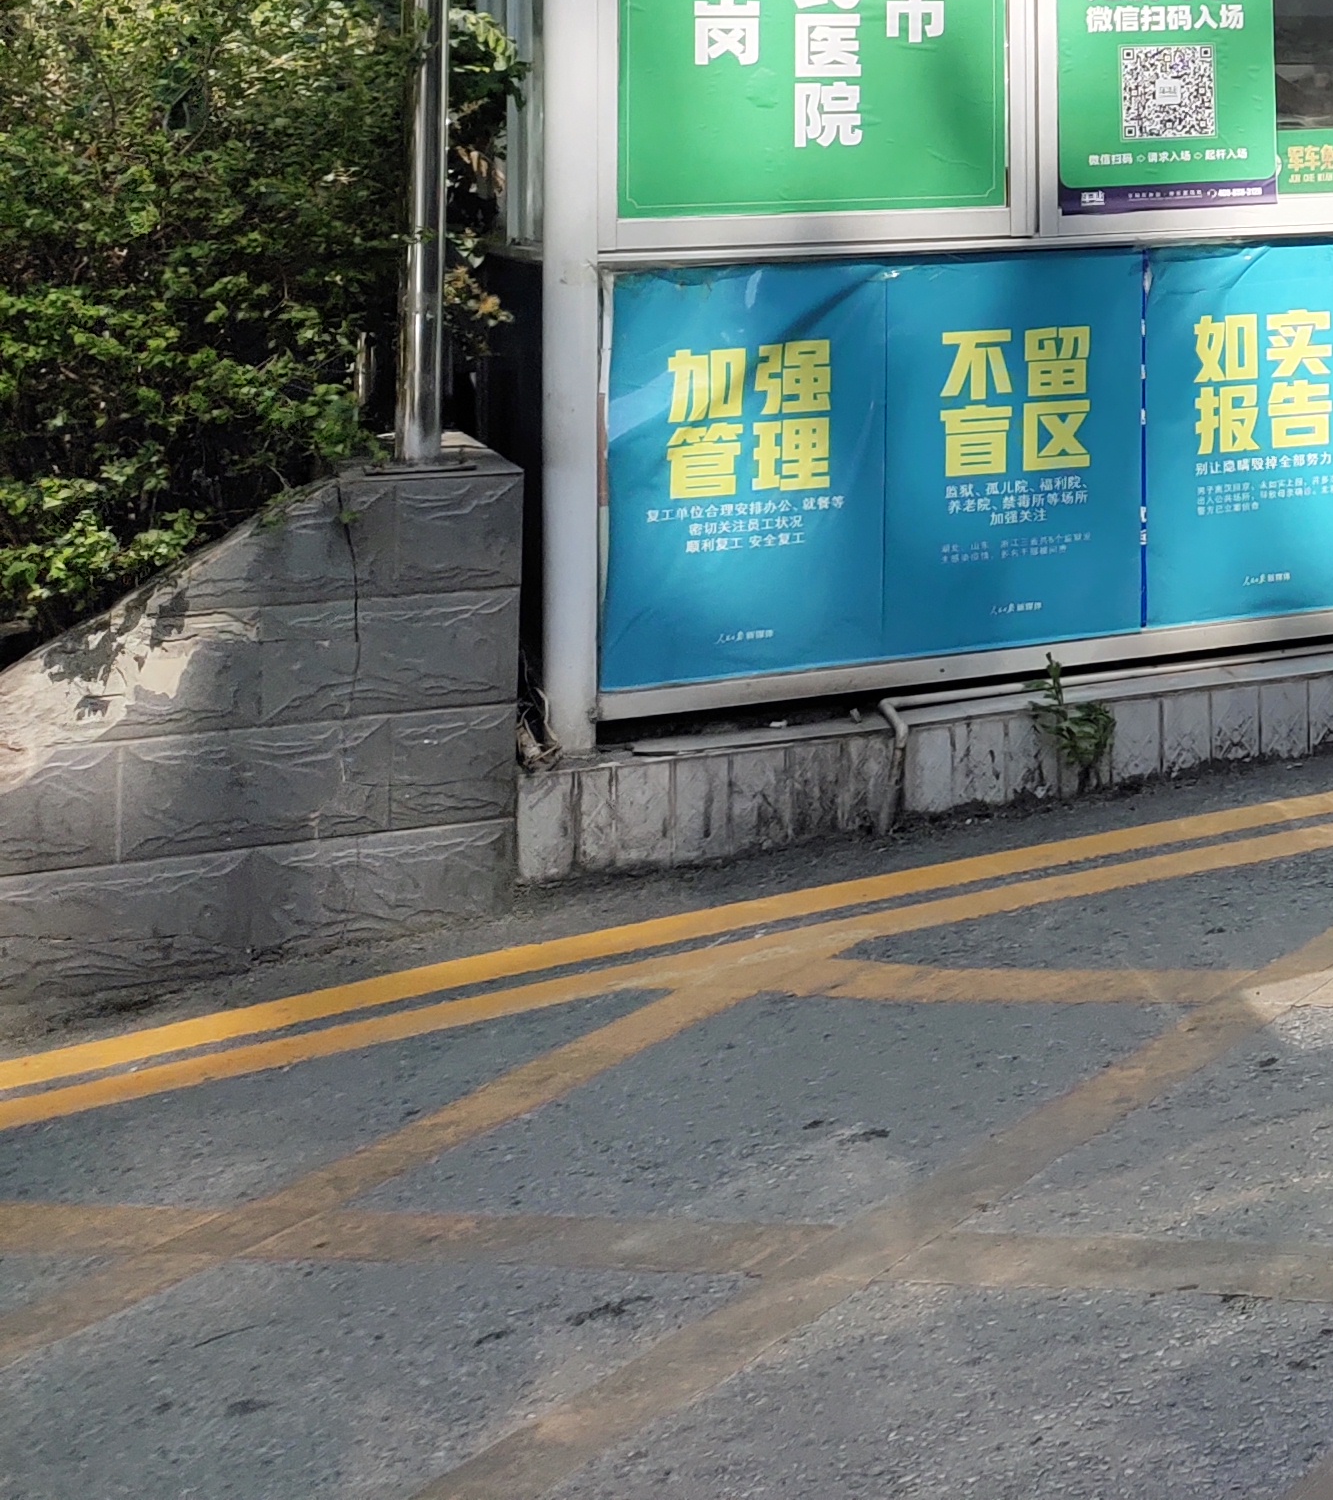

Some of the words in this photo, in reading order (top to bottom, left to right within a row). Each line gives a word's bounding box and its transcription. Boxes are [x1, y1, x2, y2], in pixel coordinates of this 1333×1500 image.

[1085, 4, 1245, 33] 微信扫码入场
[1088, 153, 1133, 166] 微信扫码
[939, 324, 1092, 402] 不留
[1193, 308, 1333, 387] 如实
[666, 339, 832, 425] 加强
[939, 397, 1092, 479] 盲区
[1193, 381, 1333, 458] 报告
[665, 414, 832, 500] 管理
[1195, 452, 1332, 476] 别让隐瞒毁掉全部努力
[646, 495, 846, 523] 复工单位合理安排办公、就餐等
[688, 515, 804, 536] 密切关注员工状况
[989, 508, 1048, 526] 加强关注
